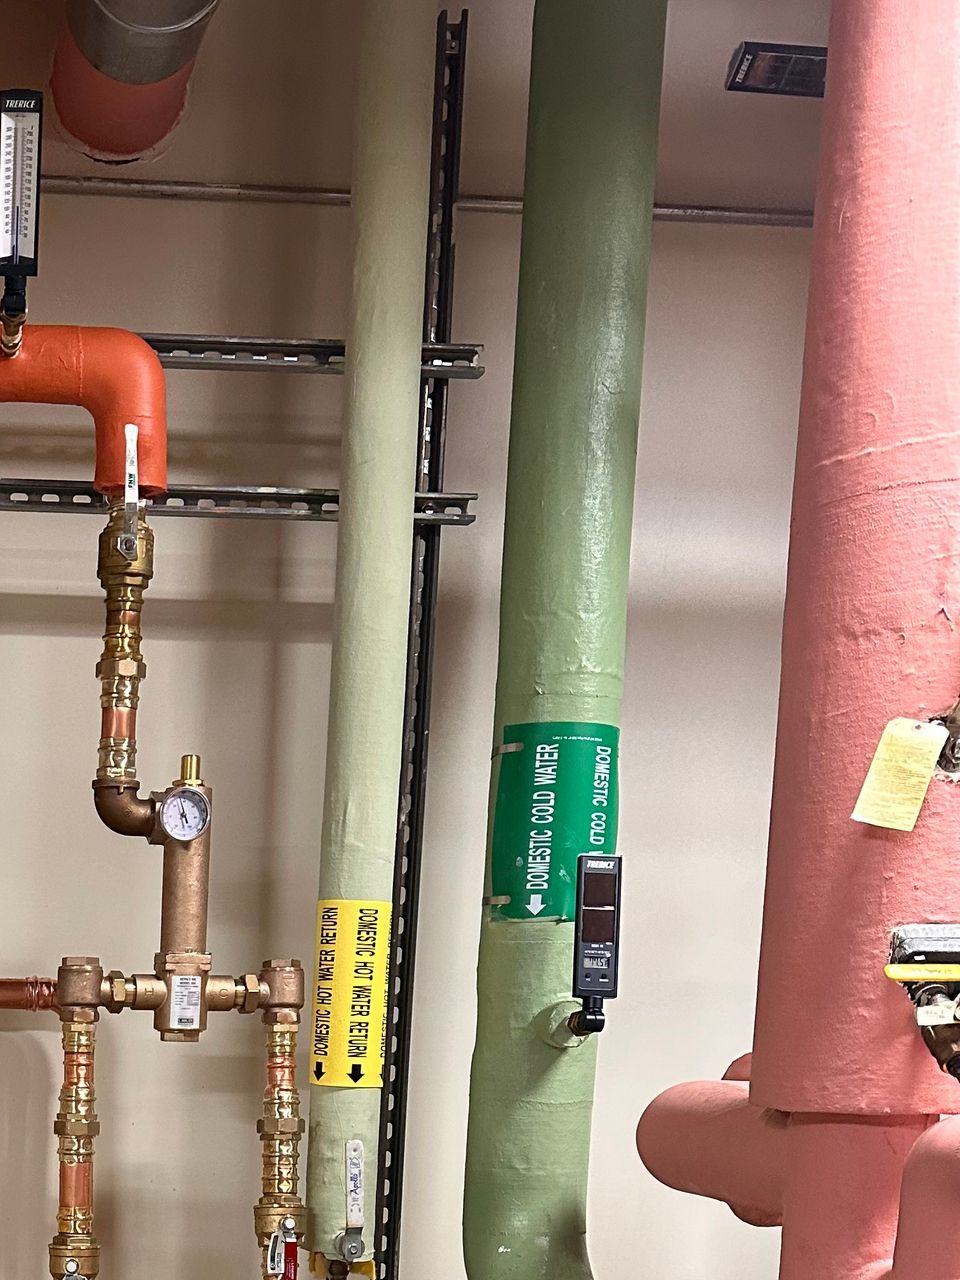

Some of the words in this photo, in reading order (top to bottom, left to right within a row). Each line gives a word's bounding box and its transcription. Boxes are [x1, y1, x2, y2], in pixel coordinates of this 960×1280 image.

[735, 53, 753, 83] TRERICE
[6, 99, 35, 109] TRERICE
[534, 743, 559, 786] WATER
[592, 745, 611, 807] DOMESTIC
[531, 790, 555, 824] COLD
[590, 812, 606, 845] COLD
[526, 829, 552, 889] DOMESTIC
[321, 907, 338, 945] RETURN
[355, 908, 378, 957] DOMESTIC
[318, 949, 335, 981] WATER
[353, 961, 374, 980] HOT
[317, 985, 332, 1005] HOT
[351, 985, 372, 1017] WATER
[314, 1009, 330, 1056] DOMESTIC
[347, 1021, 369, 1058] RETURN
[350, 1172, 361, 1195] Apollo
